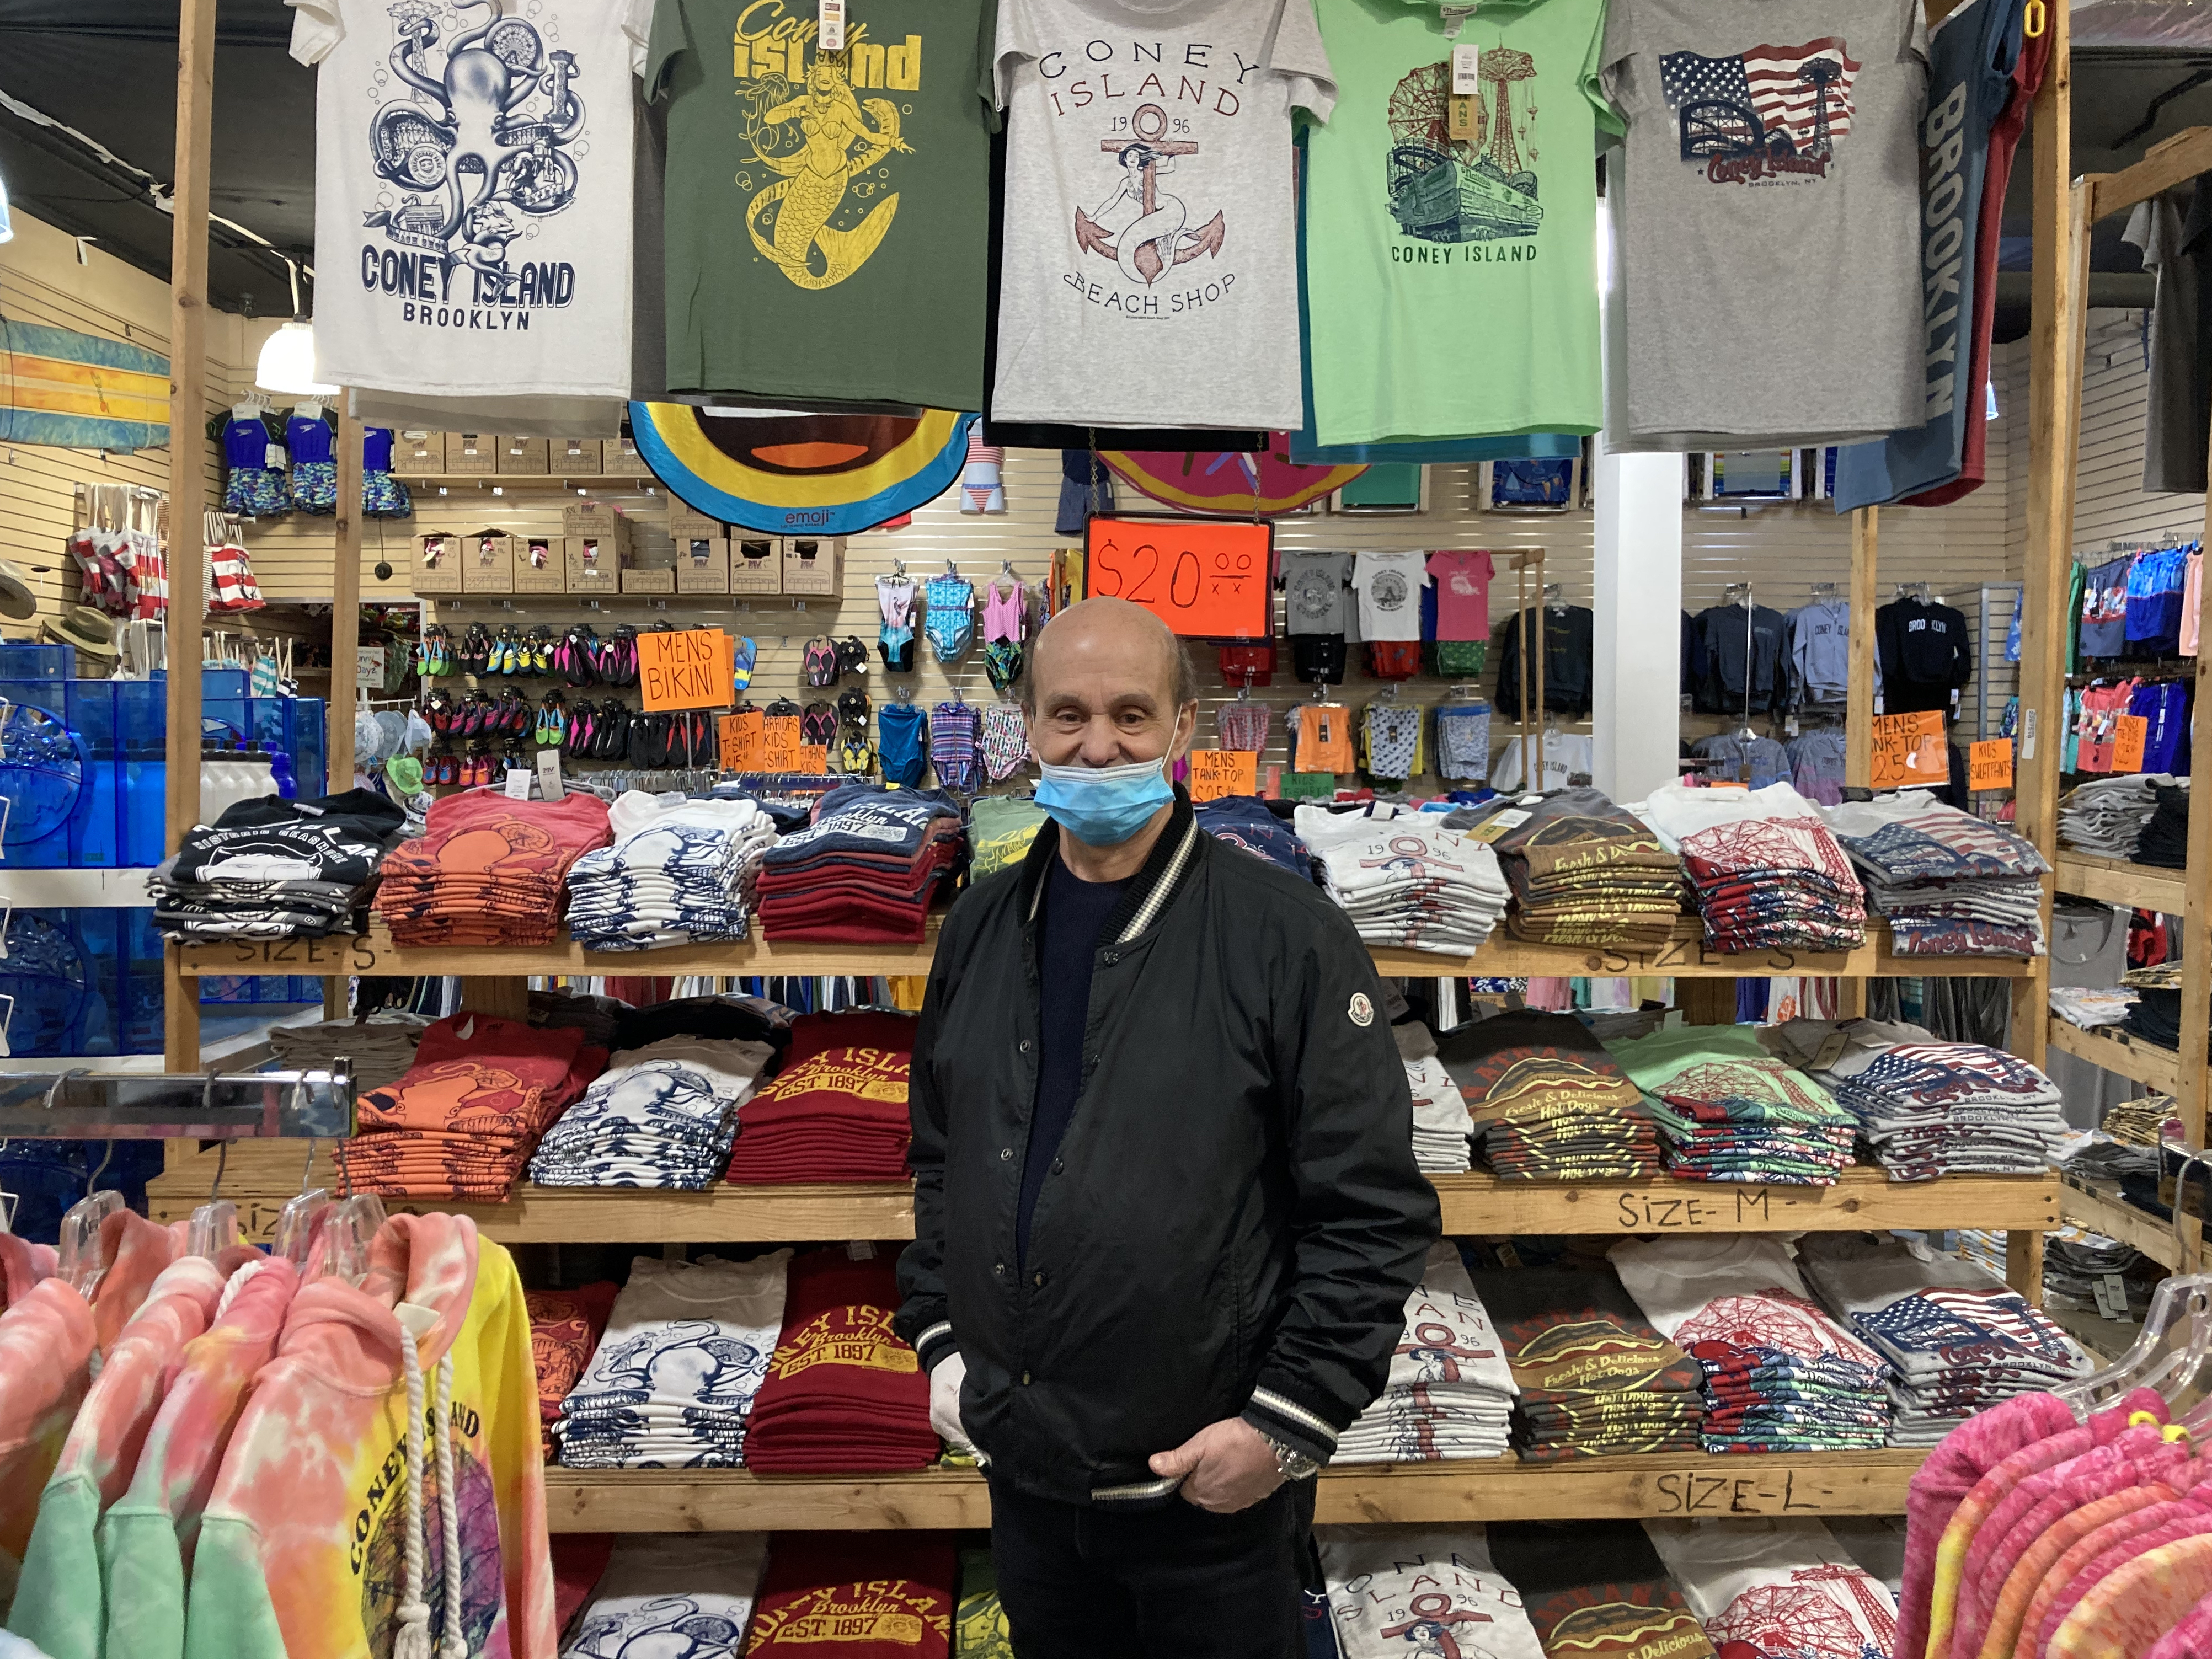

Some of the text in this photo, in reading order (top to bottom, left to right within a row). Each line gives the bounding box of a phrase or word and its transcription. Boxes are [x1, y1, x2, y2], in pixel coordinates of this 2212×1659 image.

[736, 0, 870, 62] Cony
[1038, 40, 1260, 84] CONEY
[1050, 73, 1240, 116] ISLAND
[1110, 116, 1190, 134] 19 96
[1392, 244, 1537, 265] CONEY ISLAND
[361, 245, 576, 309] CONEY ISLAND
[1063, 271, 1236, 315] BEACH SHOP
[403, 303, 531, 331] BROOKLYN
[656, 632, 713, 663] MENS
[763, 716, 798, 733] ARRIORS
[1872, 714, 1919, 736] MENS
[764, 731, 789, 749] KIDS
[1978, 741, 1997, 759] KIDS
[1205, 752, 1236, 768] MENS
[1550, 761, 1568, 775] ISLAND
[1291, 774, 1315, 785] KIDS
[191, 830, 270, 850] HISTORIC
[278, 829, 349, 865] SEASHORE
[1367, 844, 1451, 861] 19 96
[806, 1062, 890, 1083] Brooklyn
[827, 1074, 868, 1094] 1897
[1505, 1090, 1625, 1117] Fresh & Delicious
[1540, 1099, 1600, 1121] Hot Dogs
[809, 1326, 894, 1350] Brooklyn
[1460, 1334, 1481, 1347] 96
[834, 1344, 876, 1362] 1897
[1544, 1354, 1668, 1388] Fresh & Delicious
[1579, 1366, 1648, 1385] Hot Dogs
[810, 1596, 901, 1619] Brooklyn
[1387, 1592, 1478, 1623] 19 96
[833, 1617, 877, 1636] 1897
[1640, 1631, 1707, 1659] Delicious
